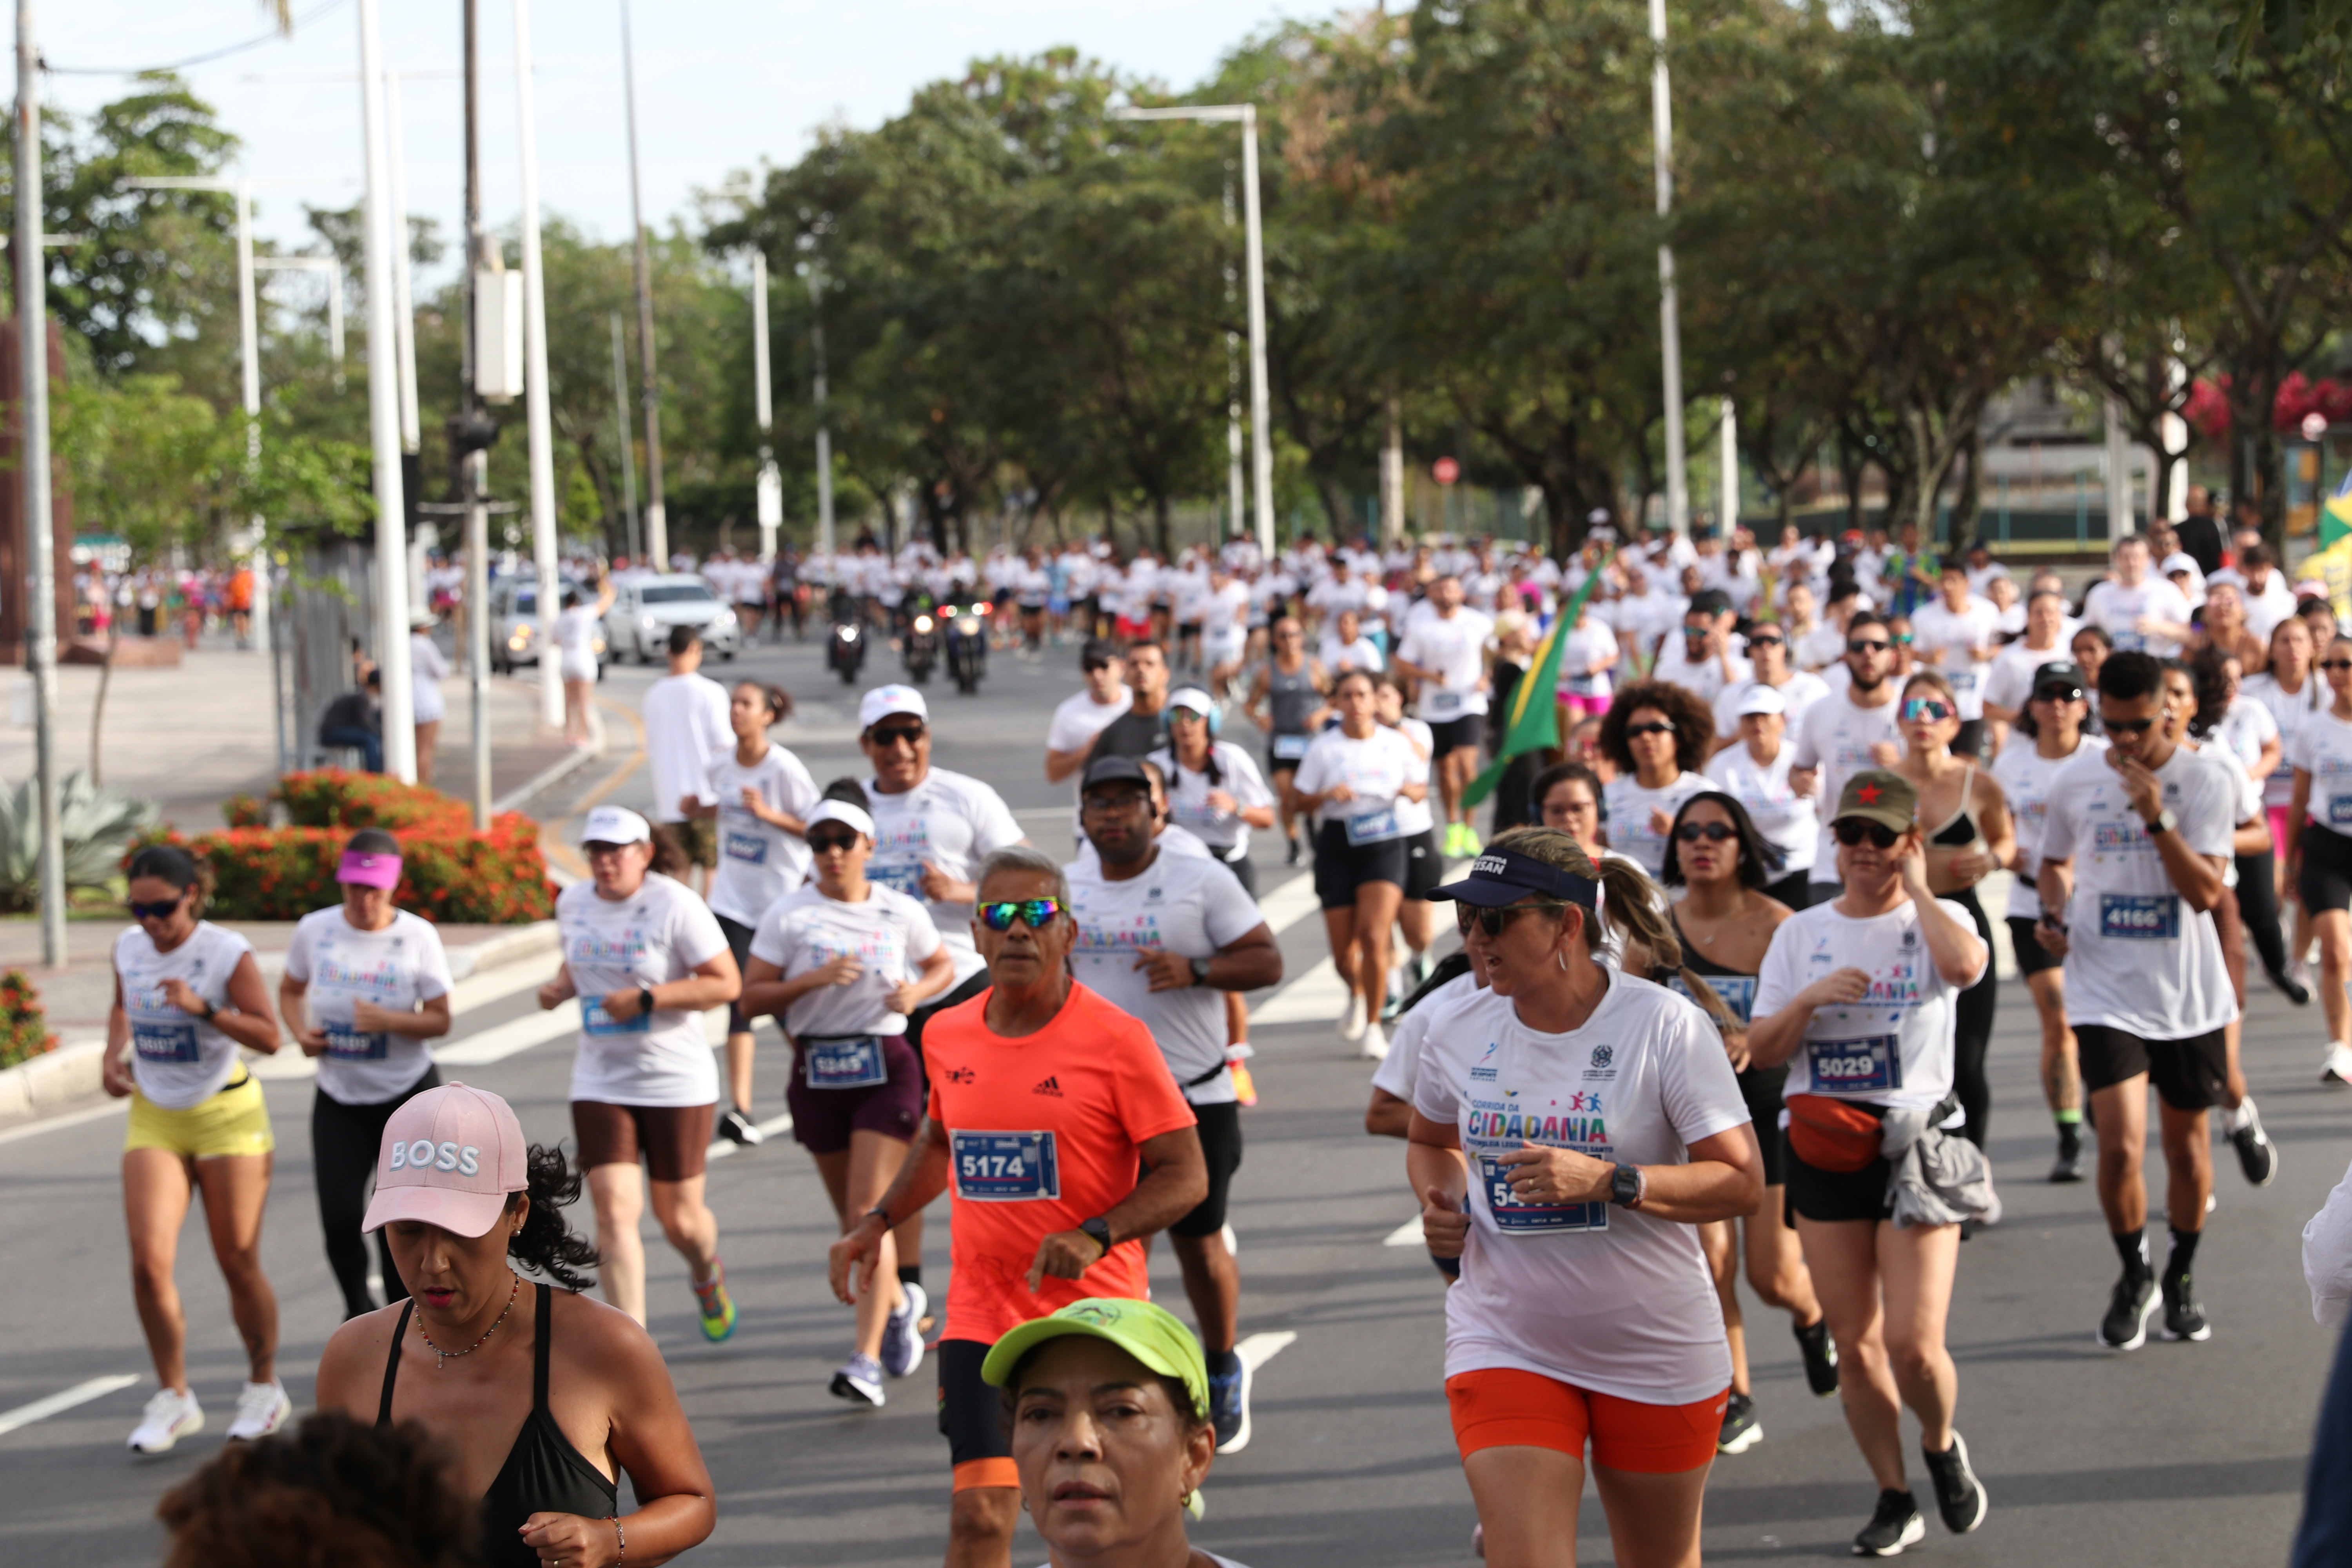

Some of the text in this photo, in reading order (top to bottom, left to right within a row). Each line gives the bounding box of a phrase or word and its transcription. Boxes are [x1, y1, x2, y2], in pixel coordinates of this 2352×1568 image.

[1818, 1055, 1874, 1077] 5029
[1472, 1099, 1519, 1112] CORRIDA DA
[1468, 1109, 1607, 1143] CIDADANIA
[390, 1139, 480, 1176] BOSS
[963, 1154, 1025, 1177] 5174
